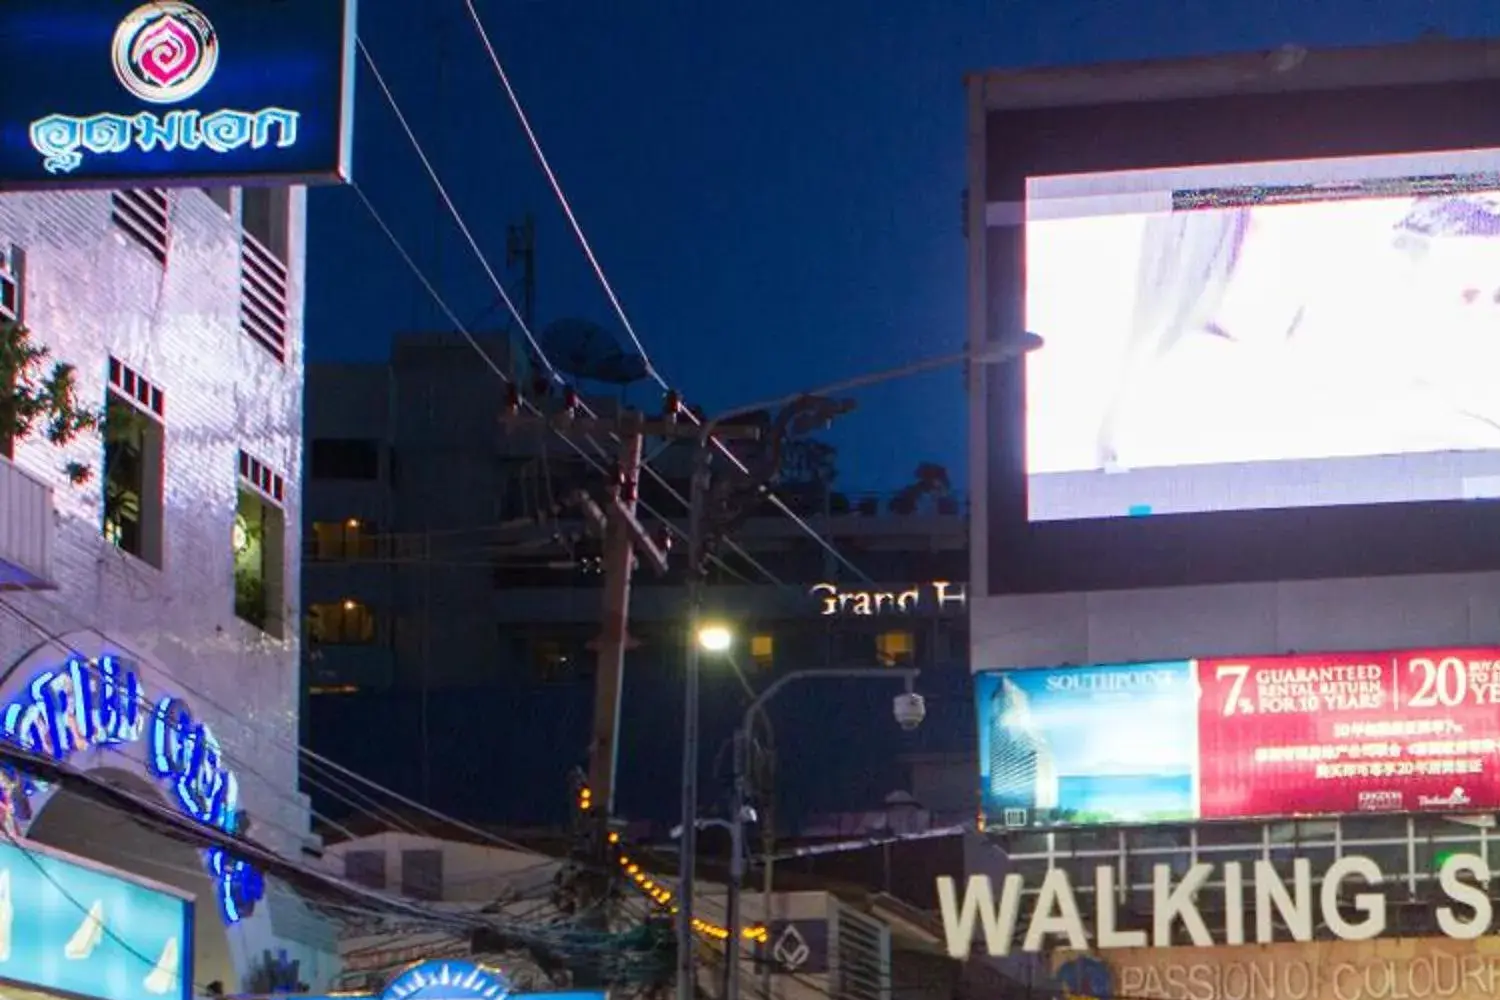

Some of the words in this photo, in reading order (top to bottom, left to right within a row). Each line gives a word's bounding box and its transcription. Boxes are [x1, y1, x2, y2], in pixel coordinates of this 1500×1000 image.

[1256, 665, 1382, 684] GUARANTEED
[1407, 656, 1467, 707] 20
[936, 855, 1388, 960] WALKING
